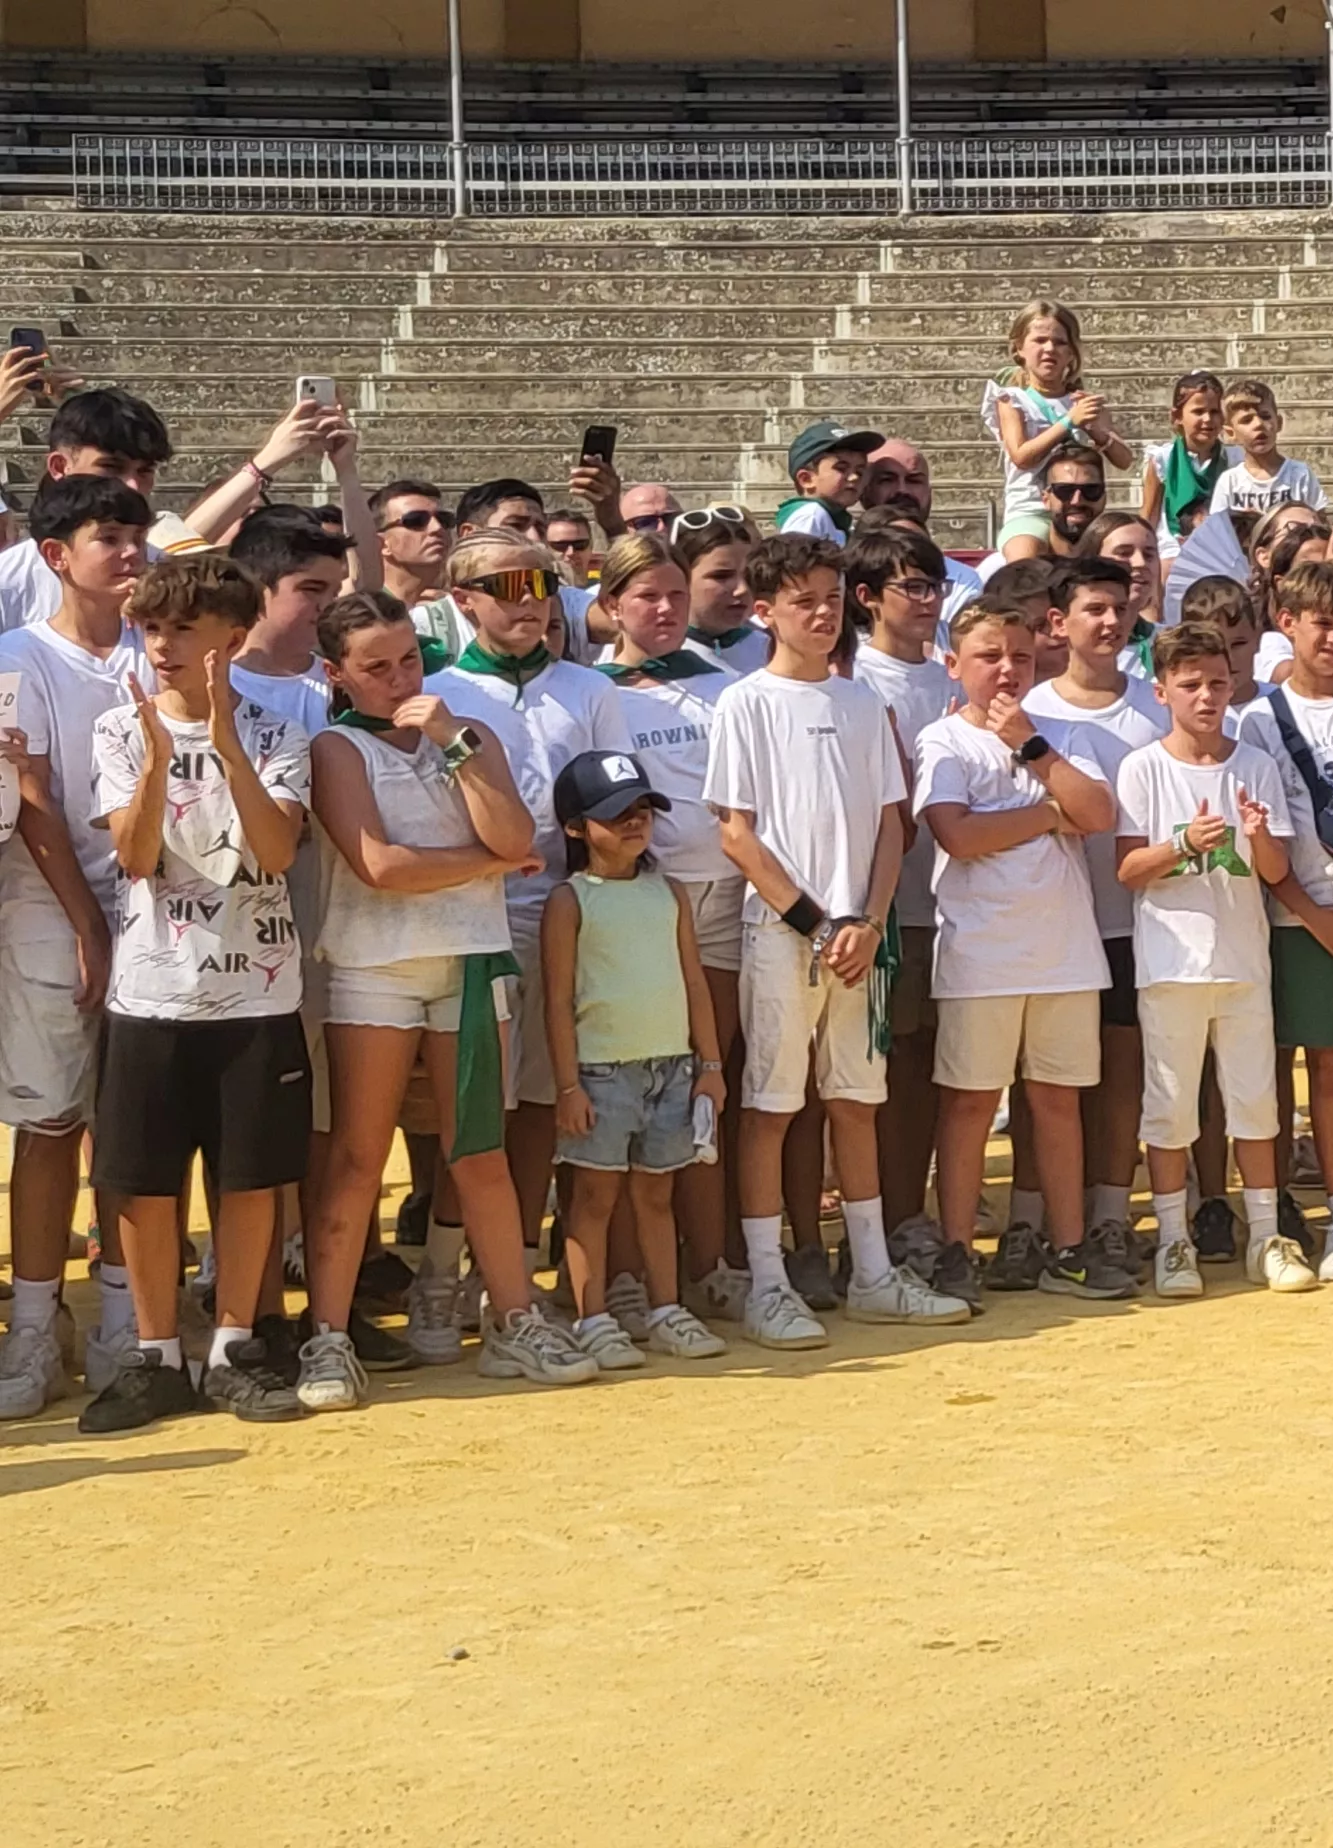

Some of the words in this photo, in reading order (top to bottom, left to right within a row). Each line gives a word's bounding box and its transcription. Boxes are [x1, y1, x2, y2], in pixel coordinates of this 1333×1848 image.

[1233, 488, 1292, 508] NEVER
[631, 723, 713, 750] ROWNI
[167, 898, 224, 923] AIR
[197, 952, 251, 973] AIR
